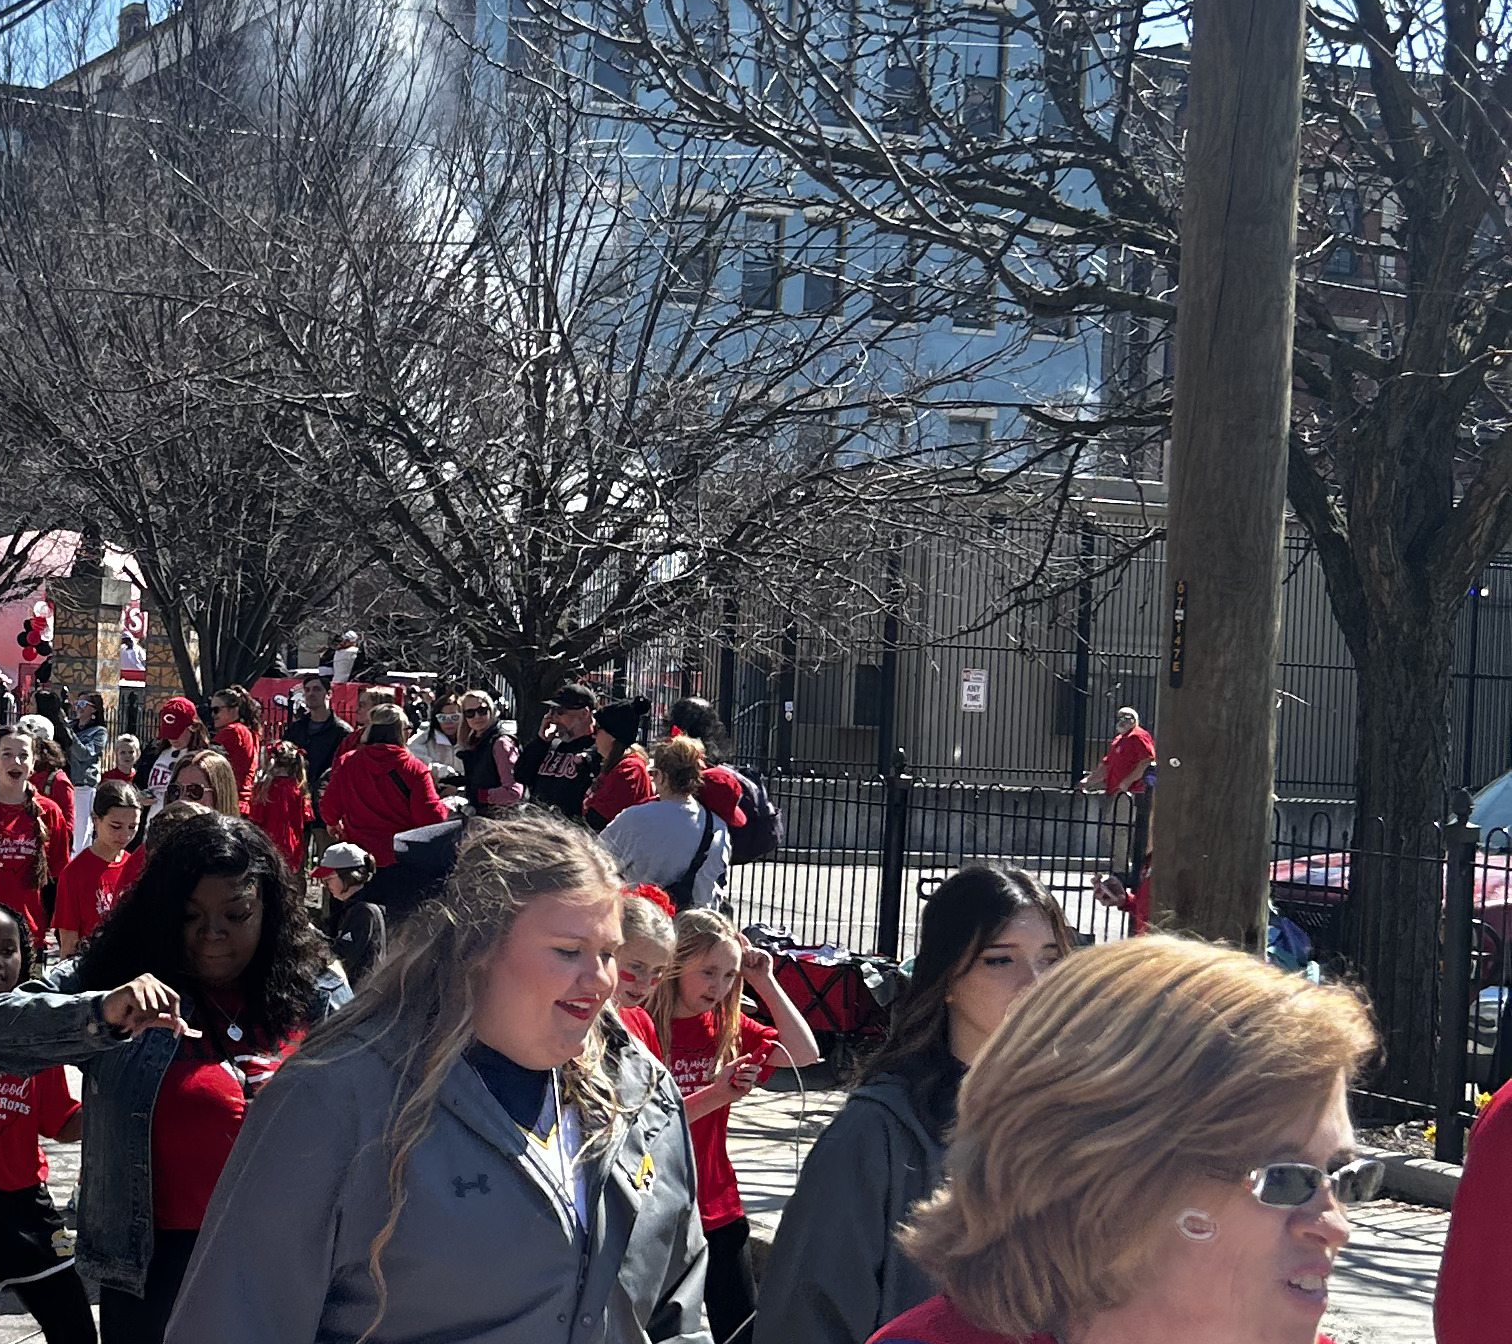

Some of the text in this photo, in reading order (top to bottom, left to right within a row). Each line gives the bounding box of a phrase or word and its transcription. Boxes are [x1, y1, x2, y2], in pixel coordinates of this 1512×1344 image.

[163, 713, 176, 724] C
[149, 767, 172, 786] RE
[0, 1097, 32, 1115] ROPES
